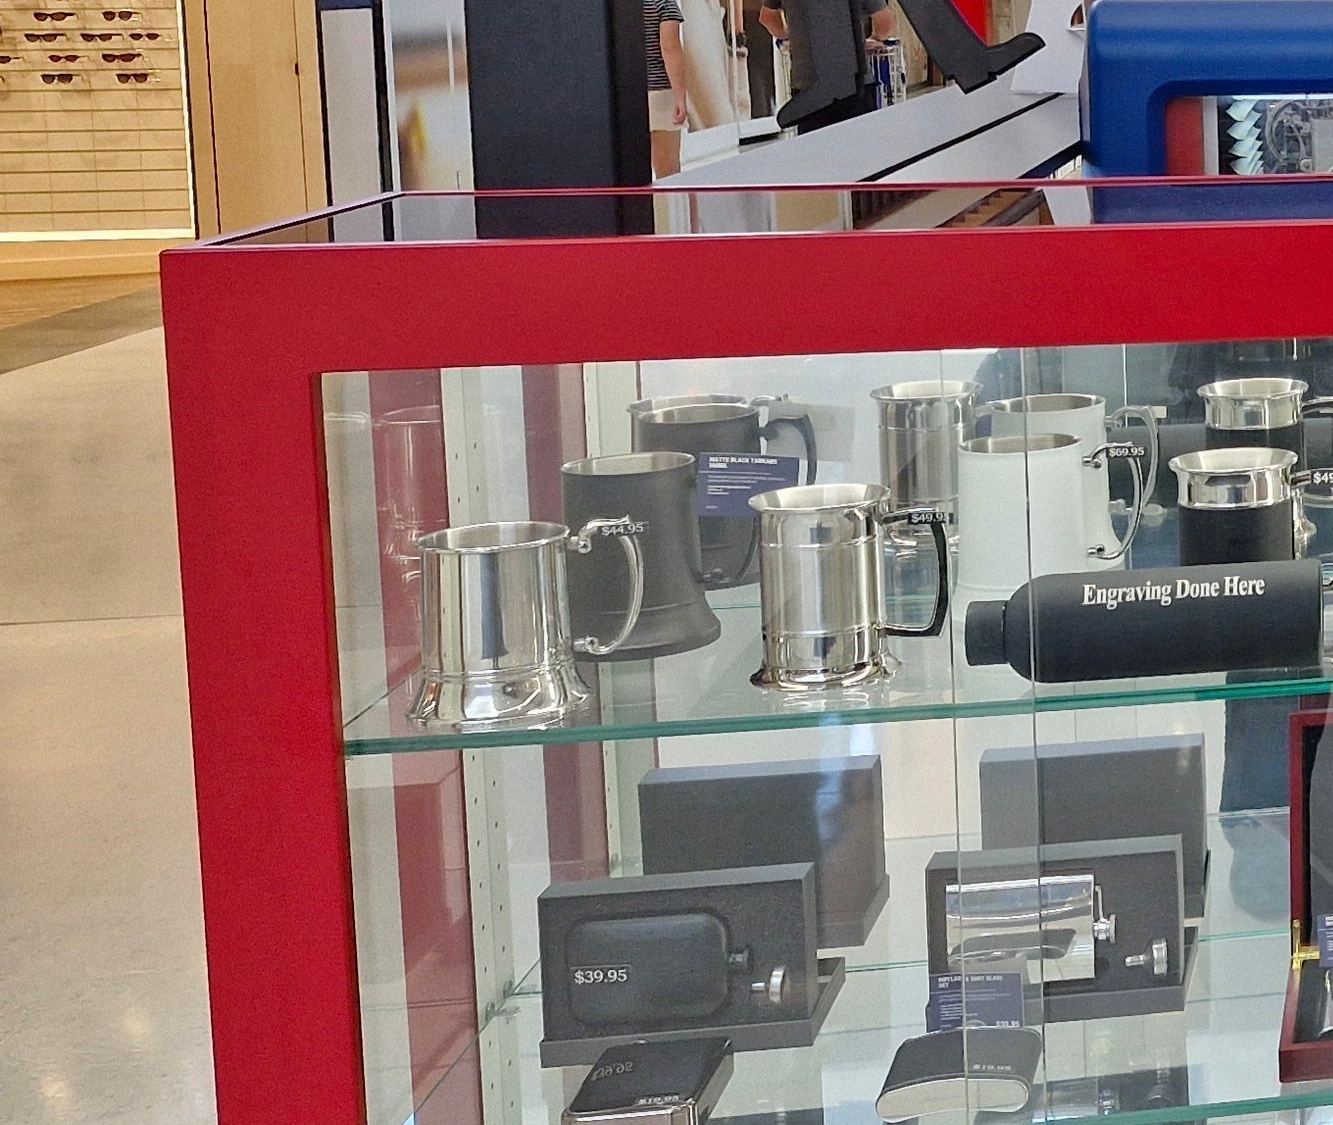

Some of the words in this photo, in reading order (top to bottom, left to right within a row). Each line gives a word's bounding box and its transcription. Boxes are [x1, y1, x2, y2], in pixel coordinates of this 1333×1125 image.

[1108, 446, 1145, 459] $69.95
[601, 522, 645, 537] $44.95
[1082, 579, 1172, 609] Engraving
[1175, 576, 1221, 600] Done
[1223, 575, 1266, 597] Here
[574, 968, 628, 986] $39.95
